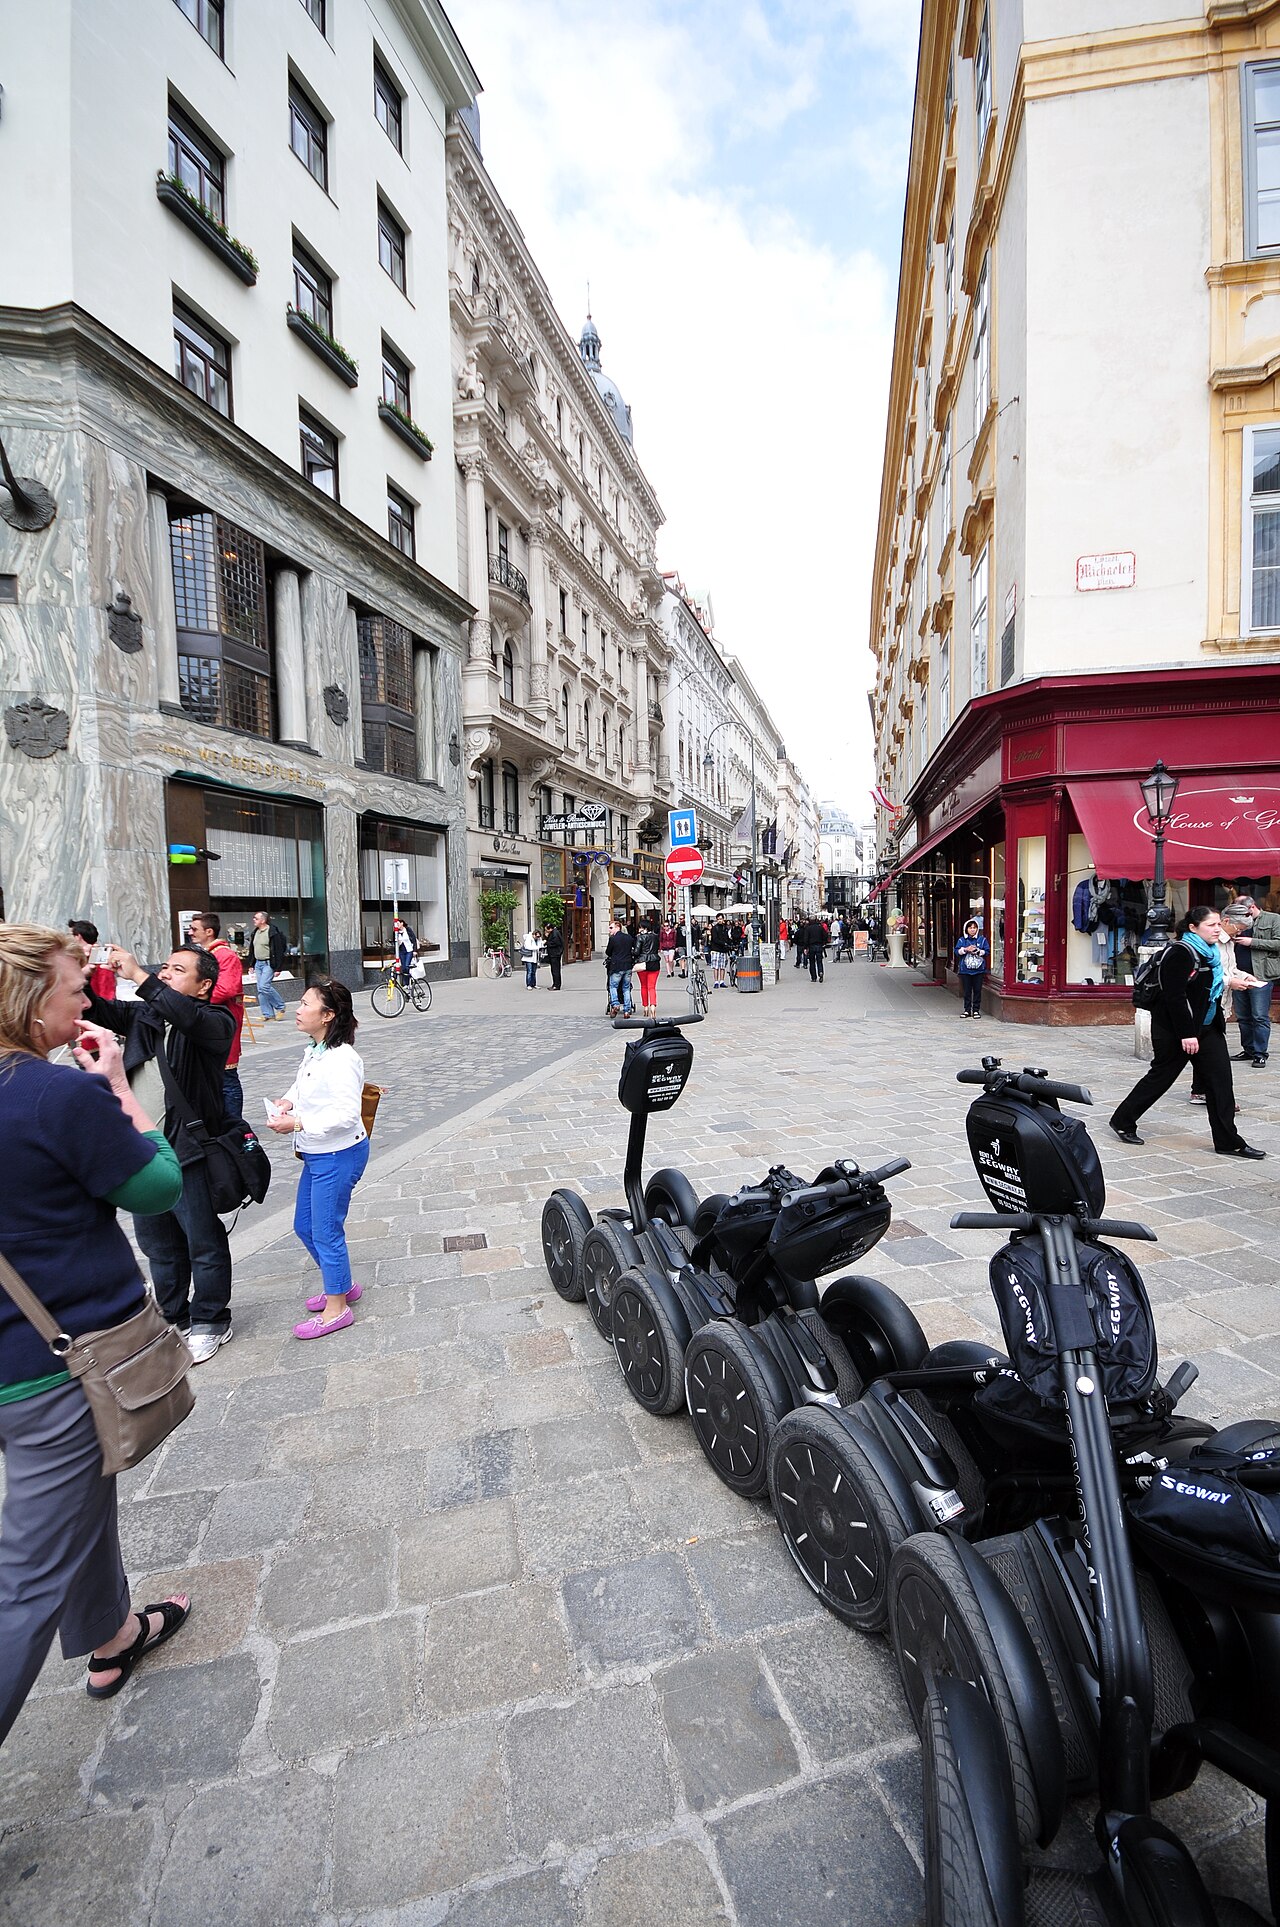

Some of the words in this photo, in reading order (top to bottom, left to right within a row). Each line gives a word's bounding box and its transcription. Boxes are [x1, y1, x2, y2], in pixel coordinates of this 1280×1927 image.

[198, 746, 302, 784] WECHSELSTUBE
[1220, 816, 1240, 830] of
[979, 1156, 1019, 1175] SEGWAY
[1008, 1273, 1037, 1344] SEGWAY
[1160, 1474, 1232, 1505] SEGWAY
